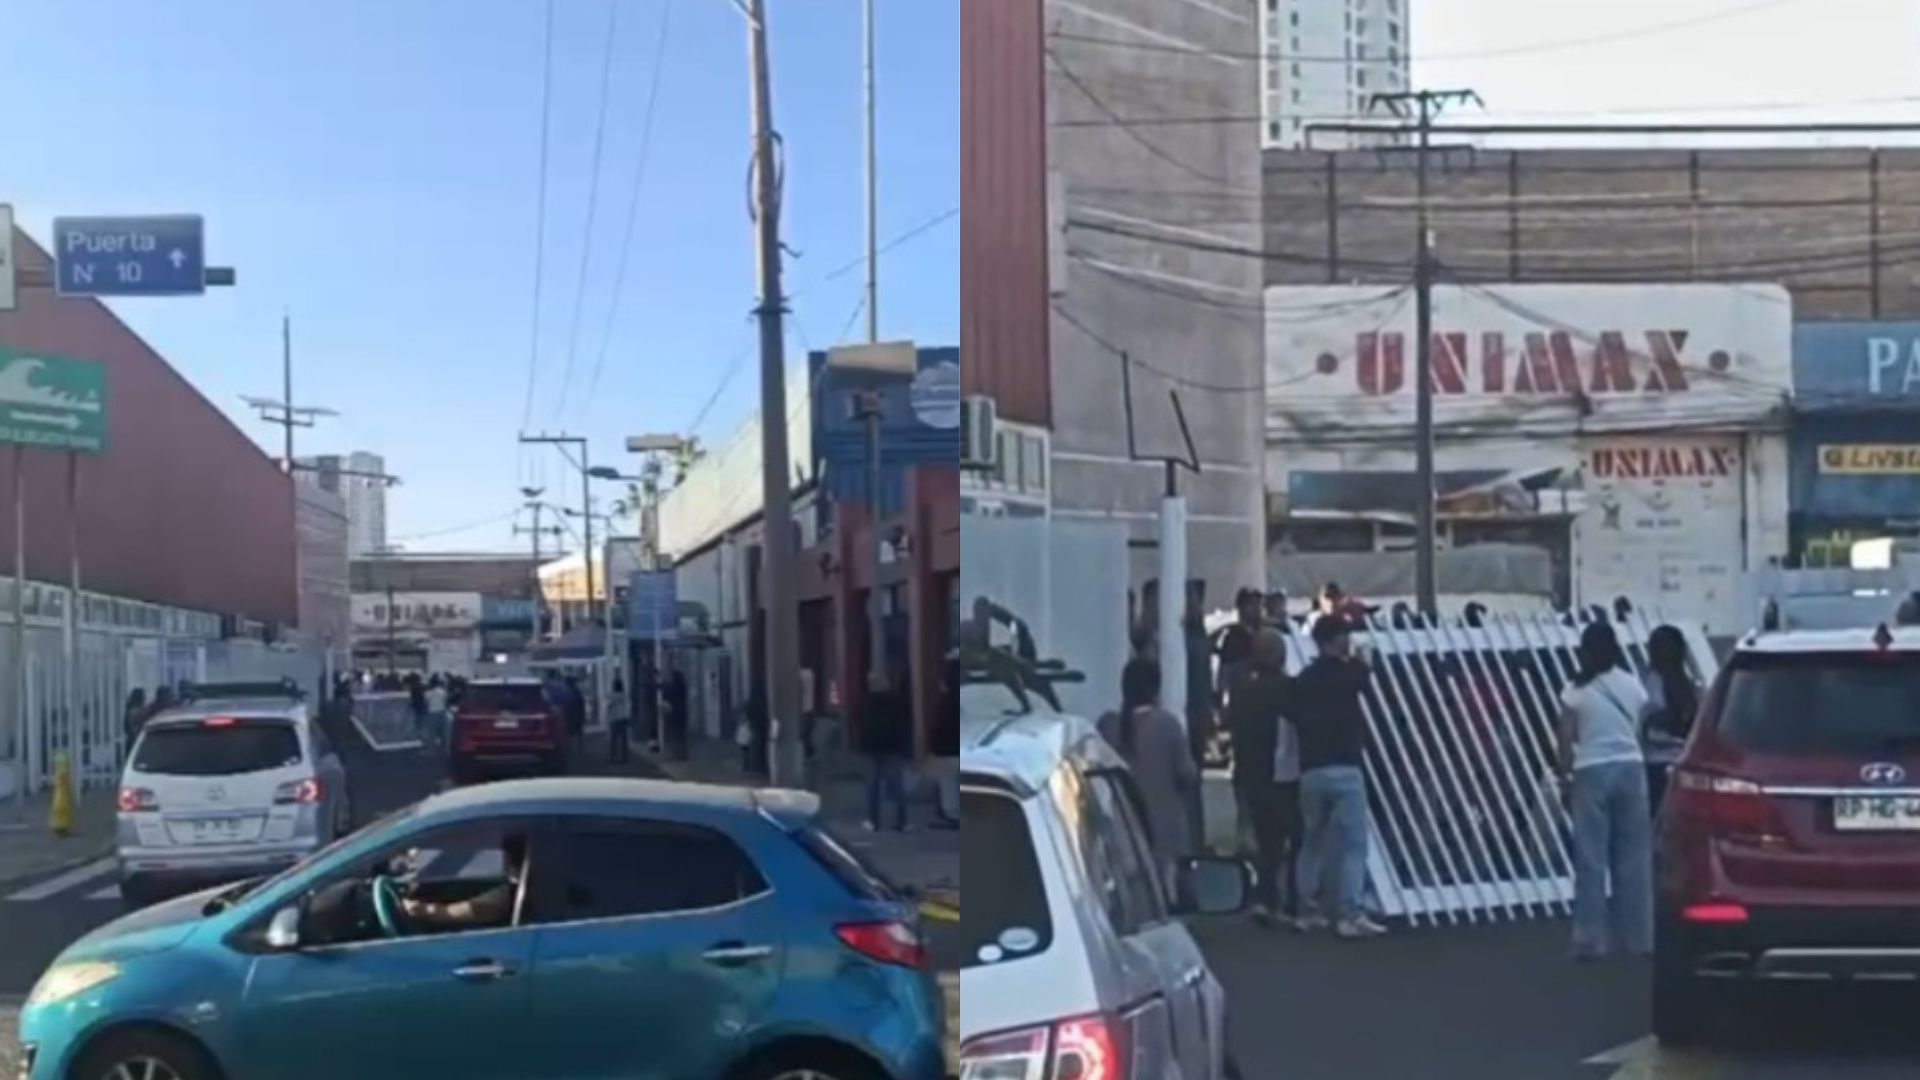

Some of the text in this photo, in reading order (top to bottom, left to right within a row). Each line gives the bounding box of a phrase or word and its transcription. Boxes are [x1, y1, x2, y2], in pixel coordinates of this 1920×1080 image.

[67, 231, 155, 252] Puerta
[117, 261, 142, 282] 10
[1356, 331, 1689, 395] UNIMAX
[1593, 448, 1729, 477] UNIMAX
